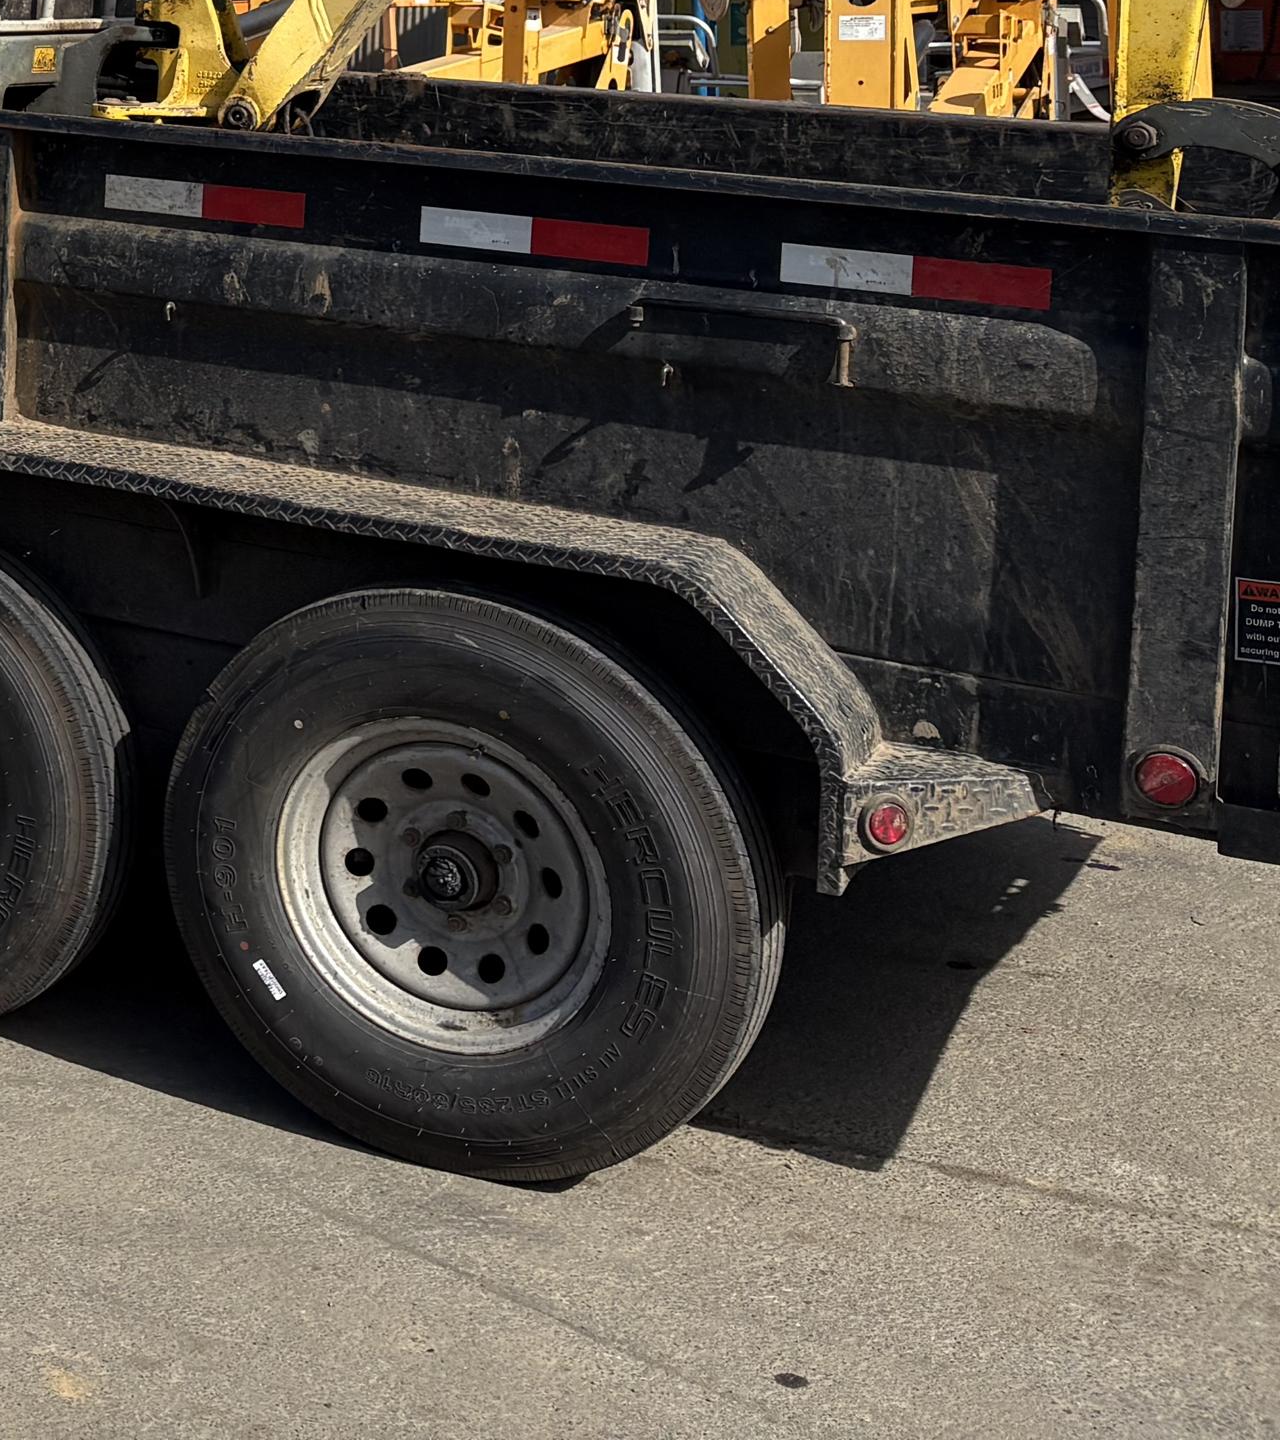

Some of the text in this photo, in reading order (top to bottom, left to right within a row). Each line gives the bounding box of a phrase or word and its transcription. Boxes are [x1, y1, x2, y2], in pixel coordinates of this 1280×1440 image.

[1250, 603, 1264, 613] Do
[1245, 617, 1275, 628] DUMP
[1240, 646, 1280, 659] securing
[211, 815, 249, 934] H-901
[581, 753, 674, 1044] HERCULES
